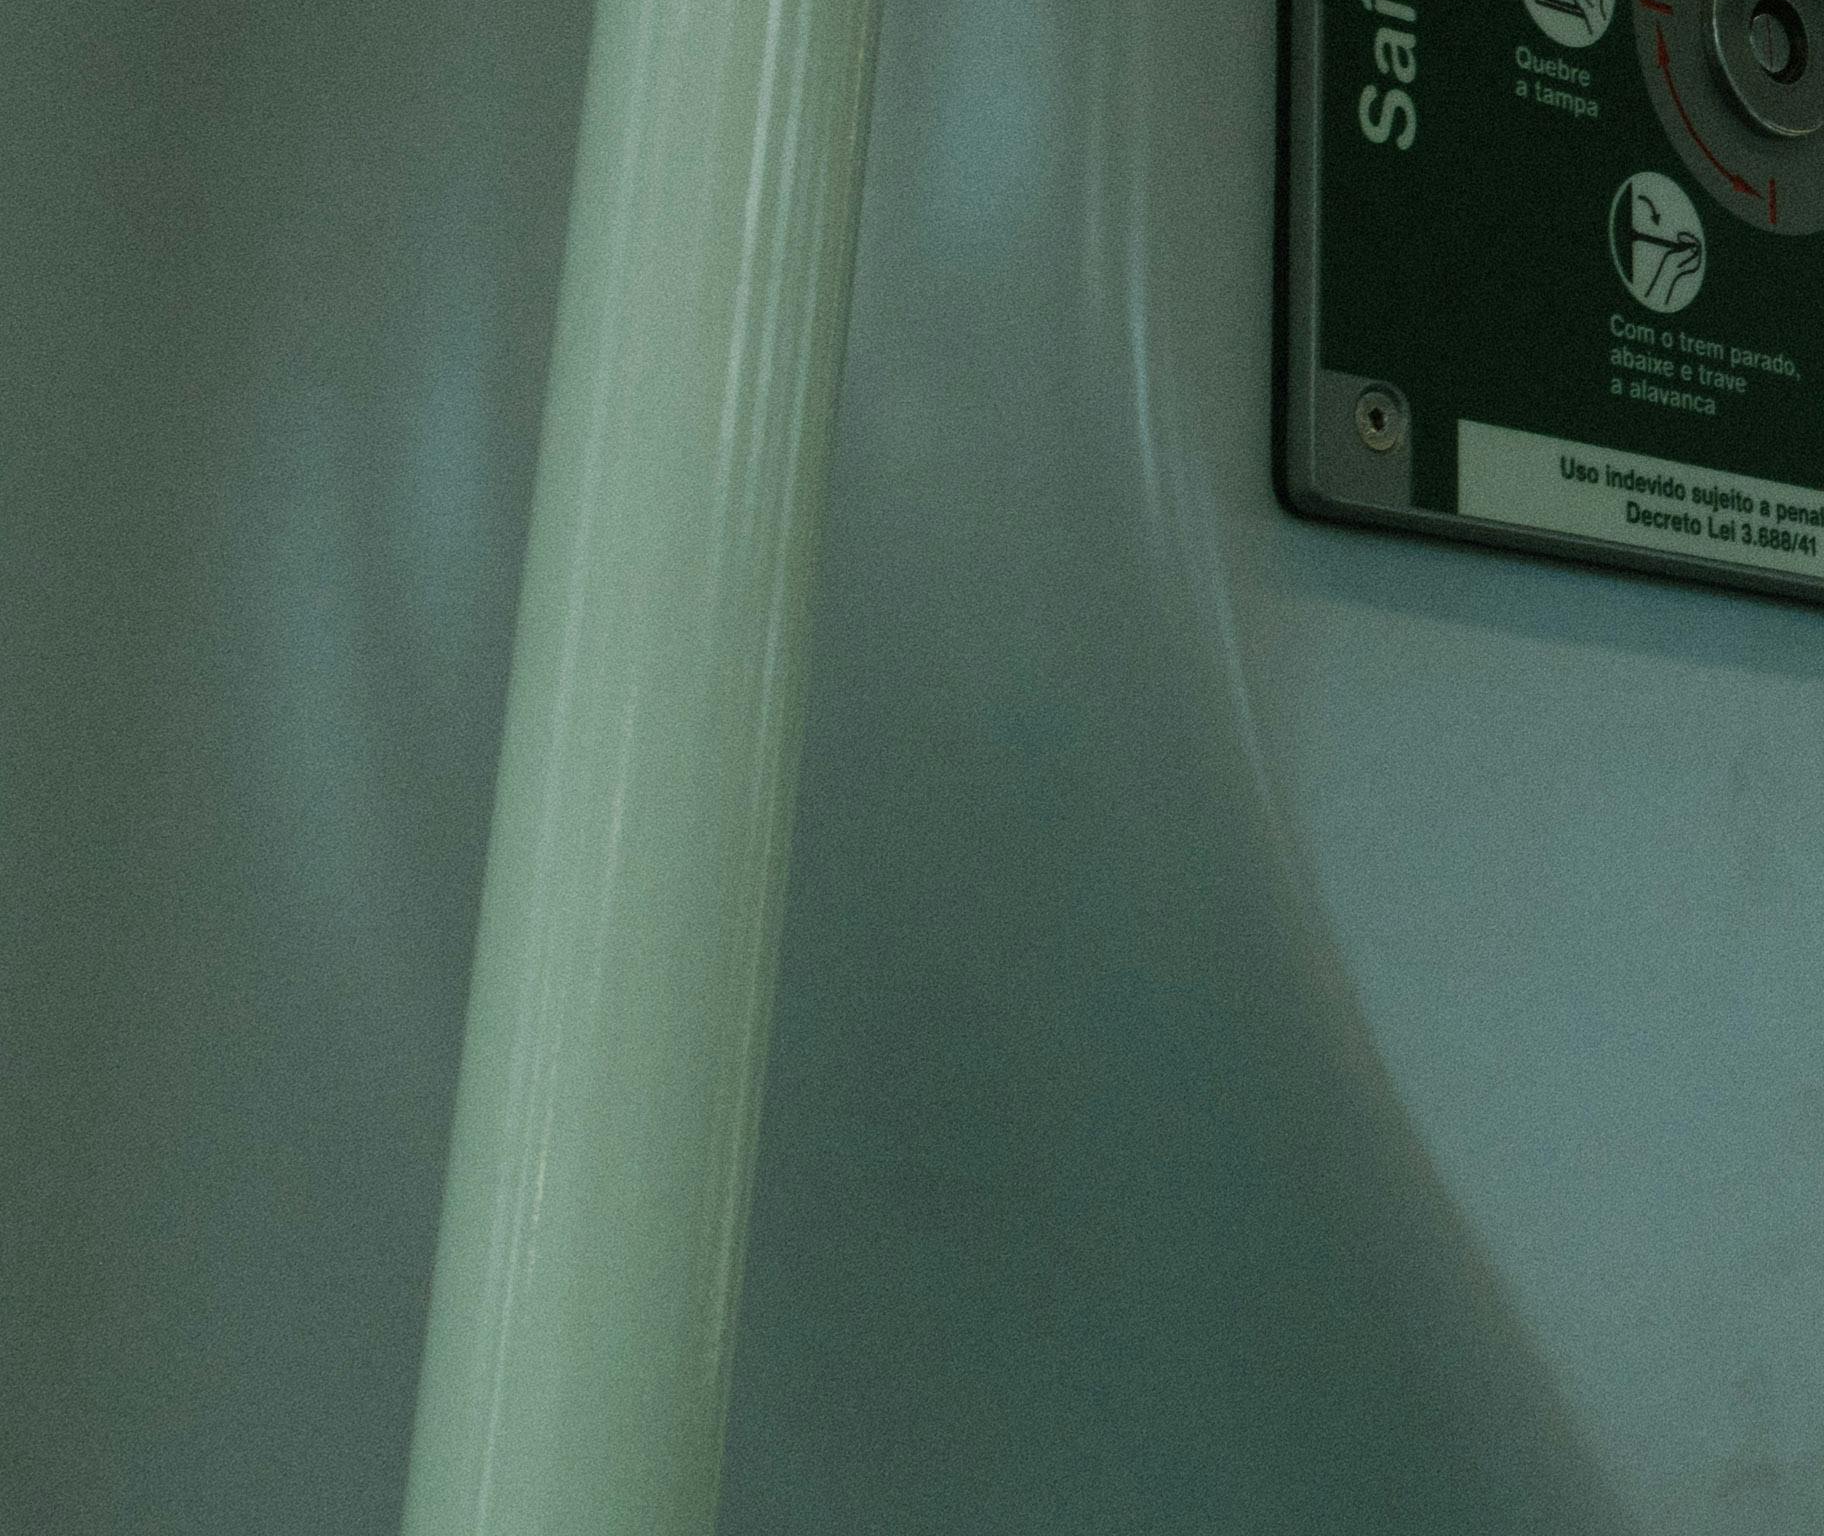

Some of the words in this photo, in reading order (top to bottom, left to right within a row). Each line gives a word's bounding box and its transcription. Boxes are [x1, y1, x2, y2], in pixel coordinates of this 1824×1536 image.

[1515, 45, 1591, 88] Quebre
[1515, 78, 1528, 100] a
[1534, 79, 1599, 119] tampa
[1609, 313, 1655, 345] Com
[1661, 330, 1674, 349] o
[1680, 331, 1724, 361] trem
[1730, 345, 1802, 381] parado,
[1609, 345, 1675, 379] abaixe
[1680, 363, 1693, 382] e
[1698, 363, 1748, 395] trave
[1609, 376, 1622, 396] a
[1630, 377, 1717, 417] alavanca
[1560, 455, 1599, 485] Uso
[1605, 464, 1686, 501] indevido
[1692, 485, 1754, 514] sujeito
[1759, 499, 1769, 517] a
[1625, 500, 1702, 537] Decreto
[1707, 516, 1735, 542] Lei
[1741, 523, 1818, 558] 3.688/41
